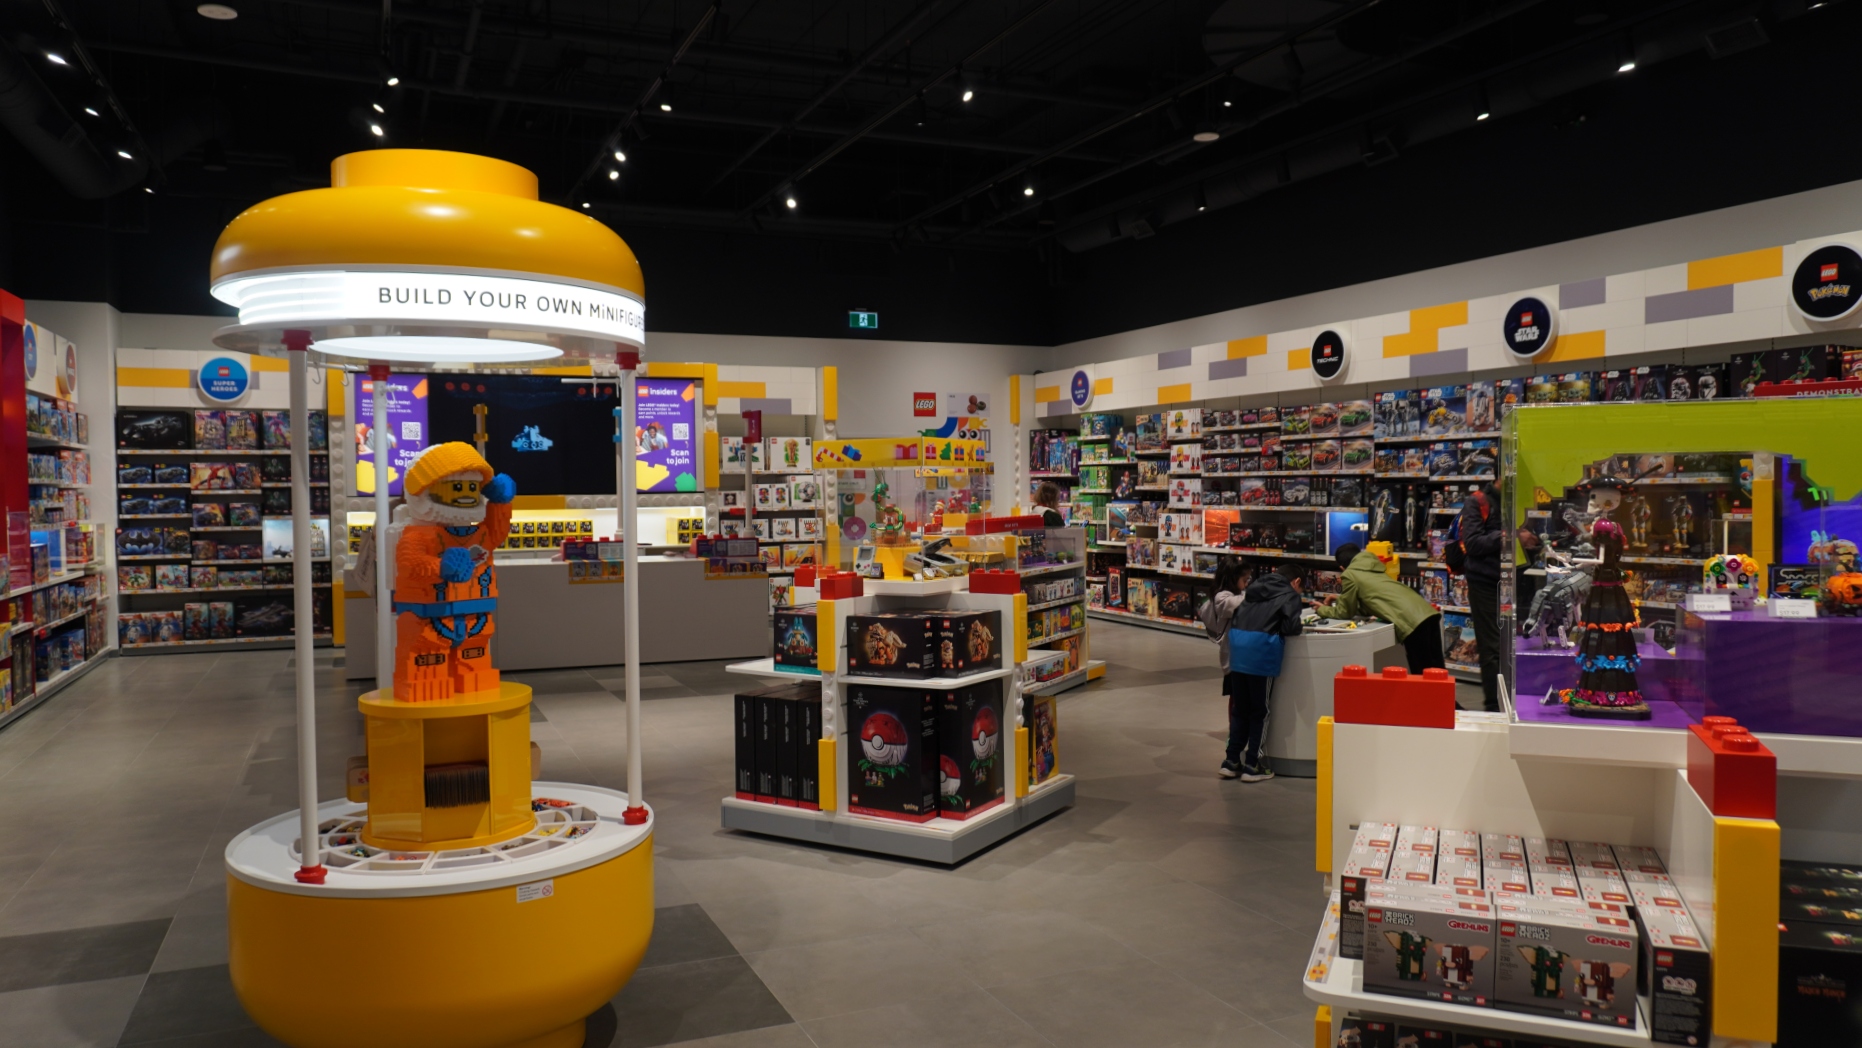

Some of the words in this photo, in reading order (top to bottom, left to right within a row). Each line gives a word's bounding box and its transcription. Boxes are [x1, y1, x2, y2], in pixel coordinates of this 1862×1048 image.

[379, 287, 451, 305] BUILD
[463, 290, 527, 310] YOUR
[537, 296, 582, 316] OWN
[1517, 326, 1538, 334] STAR
[1514, 331, 1540, 342] WARS
[1316, 356, 1338, 364] TECHNIC
[916, 400, 934, 409] LEGO
[675, 458, 689, 466] join
[1392, 911, 1414, 920] BRICK
[1385, 916, 1414, 926] HEADZ
[1448, 920, 1490, 933] GREMLINS
[1526, 925, 1550, 934] BRICK
[1519, 931, 1550, 940] HEADZ
[1587, 935, 1632, 949] GREMLINS
